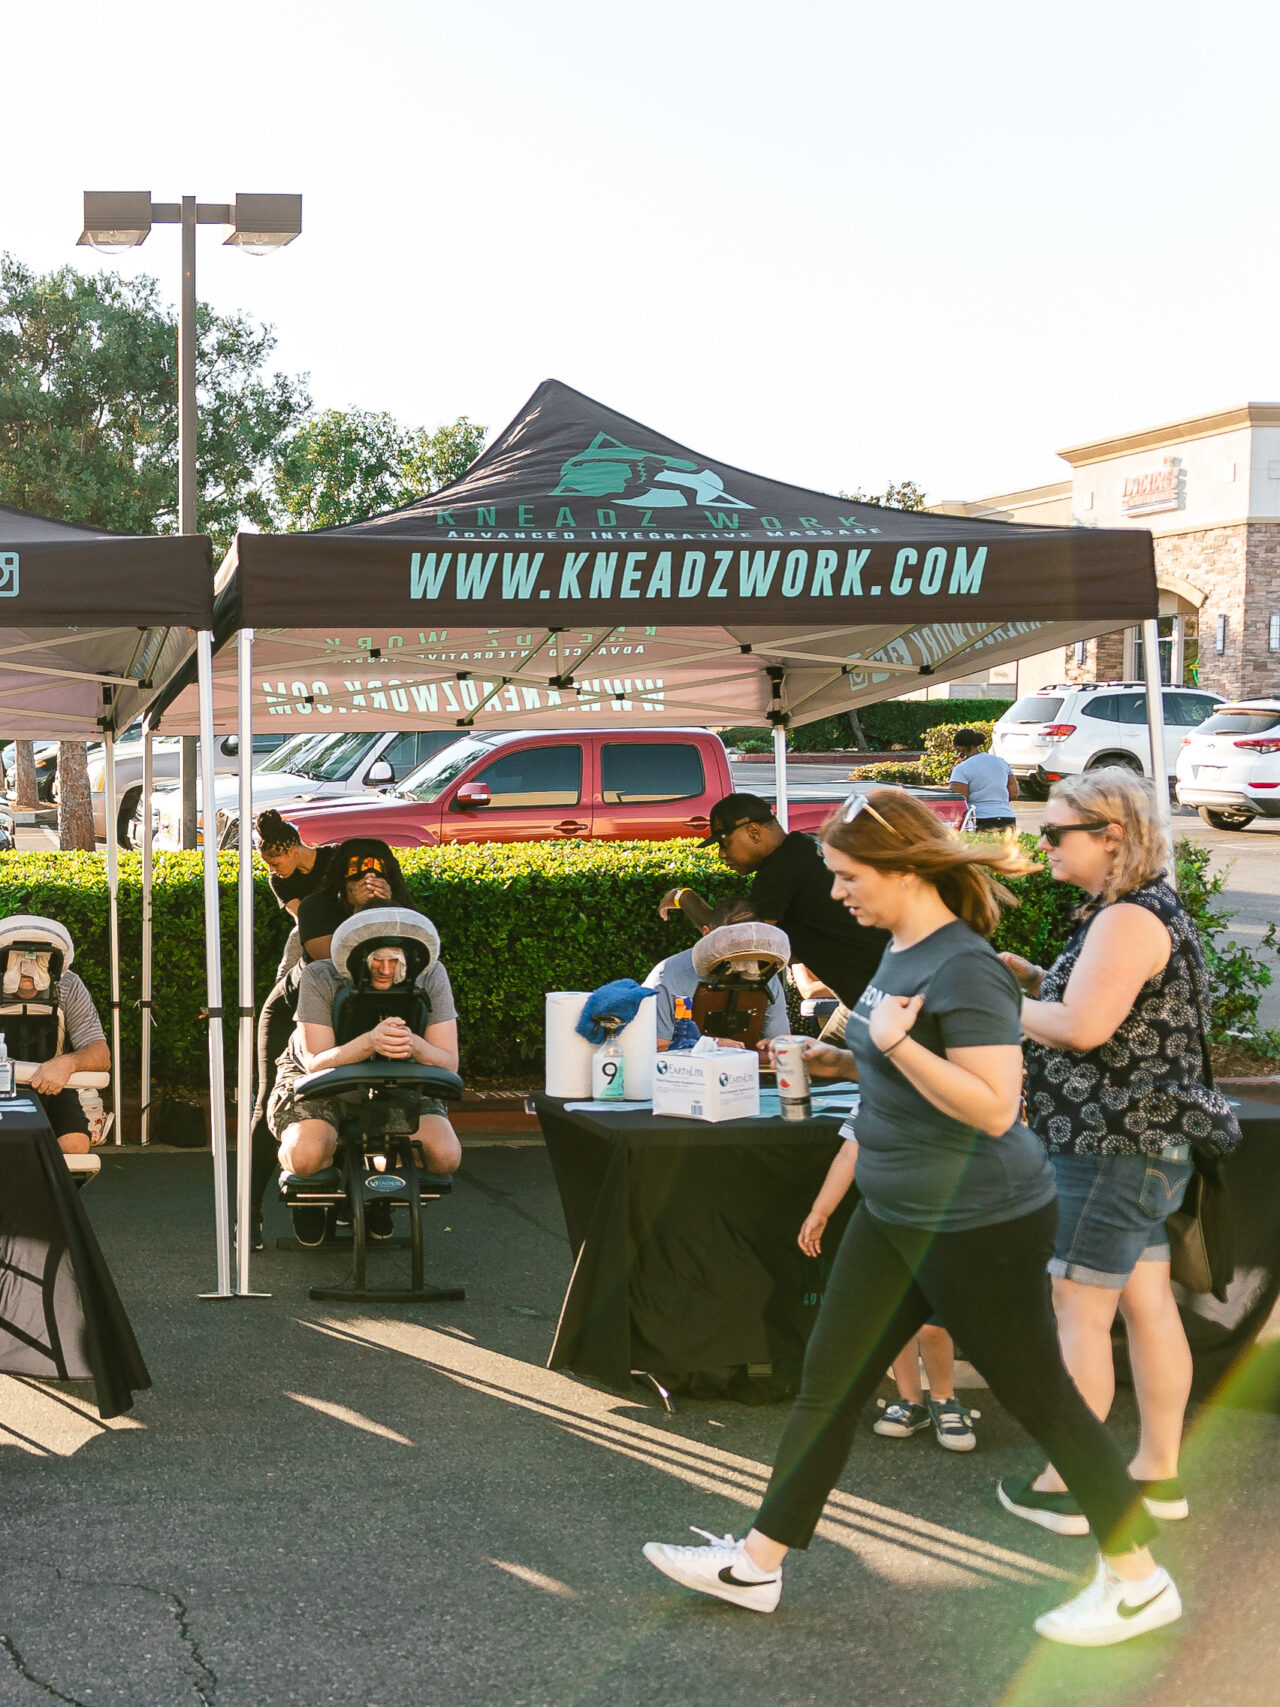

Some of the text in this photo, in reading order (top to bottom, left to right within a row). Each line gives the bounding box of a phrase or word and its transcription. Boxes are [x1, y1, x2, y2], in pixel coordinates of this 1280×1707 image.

[436, 505, 865, 529] KNEADZ WORK
[447, 527, 883, 540] ADVANCED INTEGRATIVE MASSAGE
[410, 547, 988, 600] WWW.KNEADZWORK.COM
[602, 1061, 618, 1086] 9
